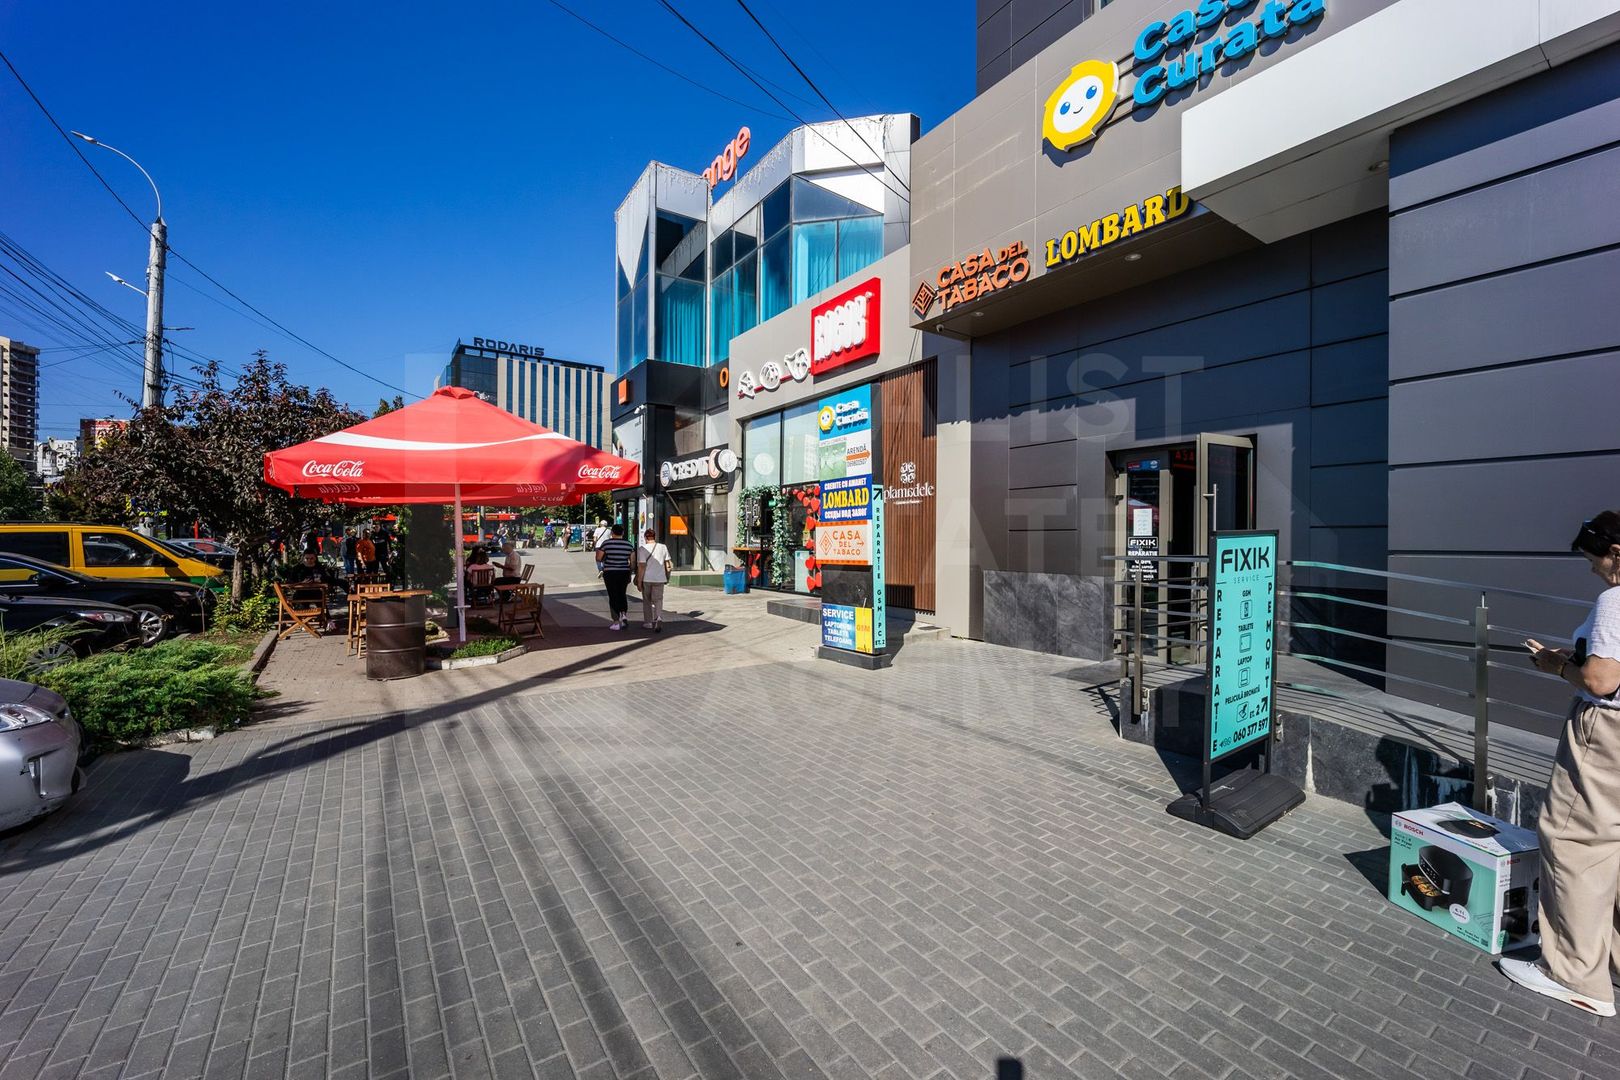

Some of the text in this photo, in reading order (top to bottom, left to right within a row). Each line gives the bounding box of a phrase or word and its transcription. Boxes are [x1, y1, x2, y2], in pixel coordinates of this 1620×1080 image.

[1133, 0, 1250, 61] Cas
[1045, 184, 1194, 268] LOMBARD
[936, 239, 1028, 289] CASA DEL
[938, 256, 1031, 312] TABACO
[473, 336, 545, 357] RODARIS
[822, 487, 870, 509] LOMBARD
[832, 530, 861, 540] CASA
[832, 548, 861, 556] TABACO
[1220, 546, 1270, 574] FIXIK
[1233, 574, 1260, 585] SERVICE
[1242, 589, 1251, 598] GSM
[822, 608, 854, 620] SERVICE
[1238, 622, 1254, 632] TABLETE
[1237, 655, 1252, 666] LAPTOP
[1255, 705, 1260, 716] 2
[1233, 727, 1246, 743] 060
[1403, 824, 1424, 836] BOSCH
